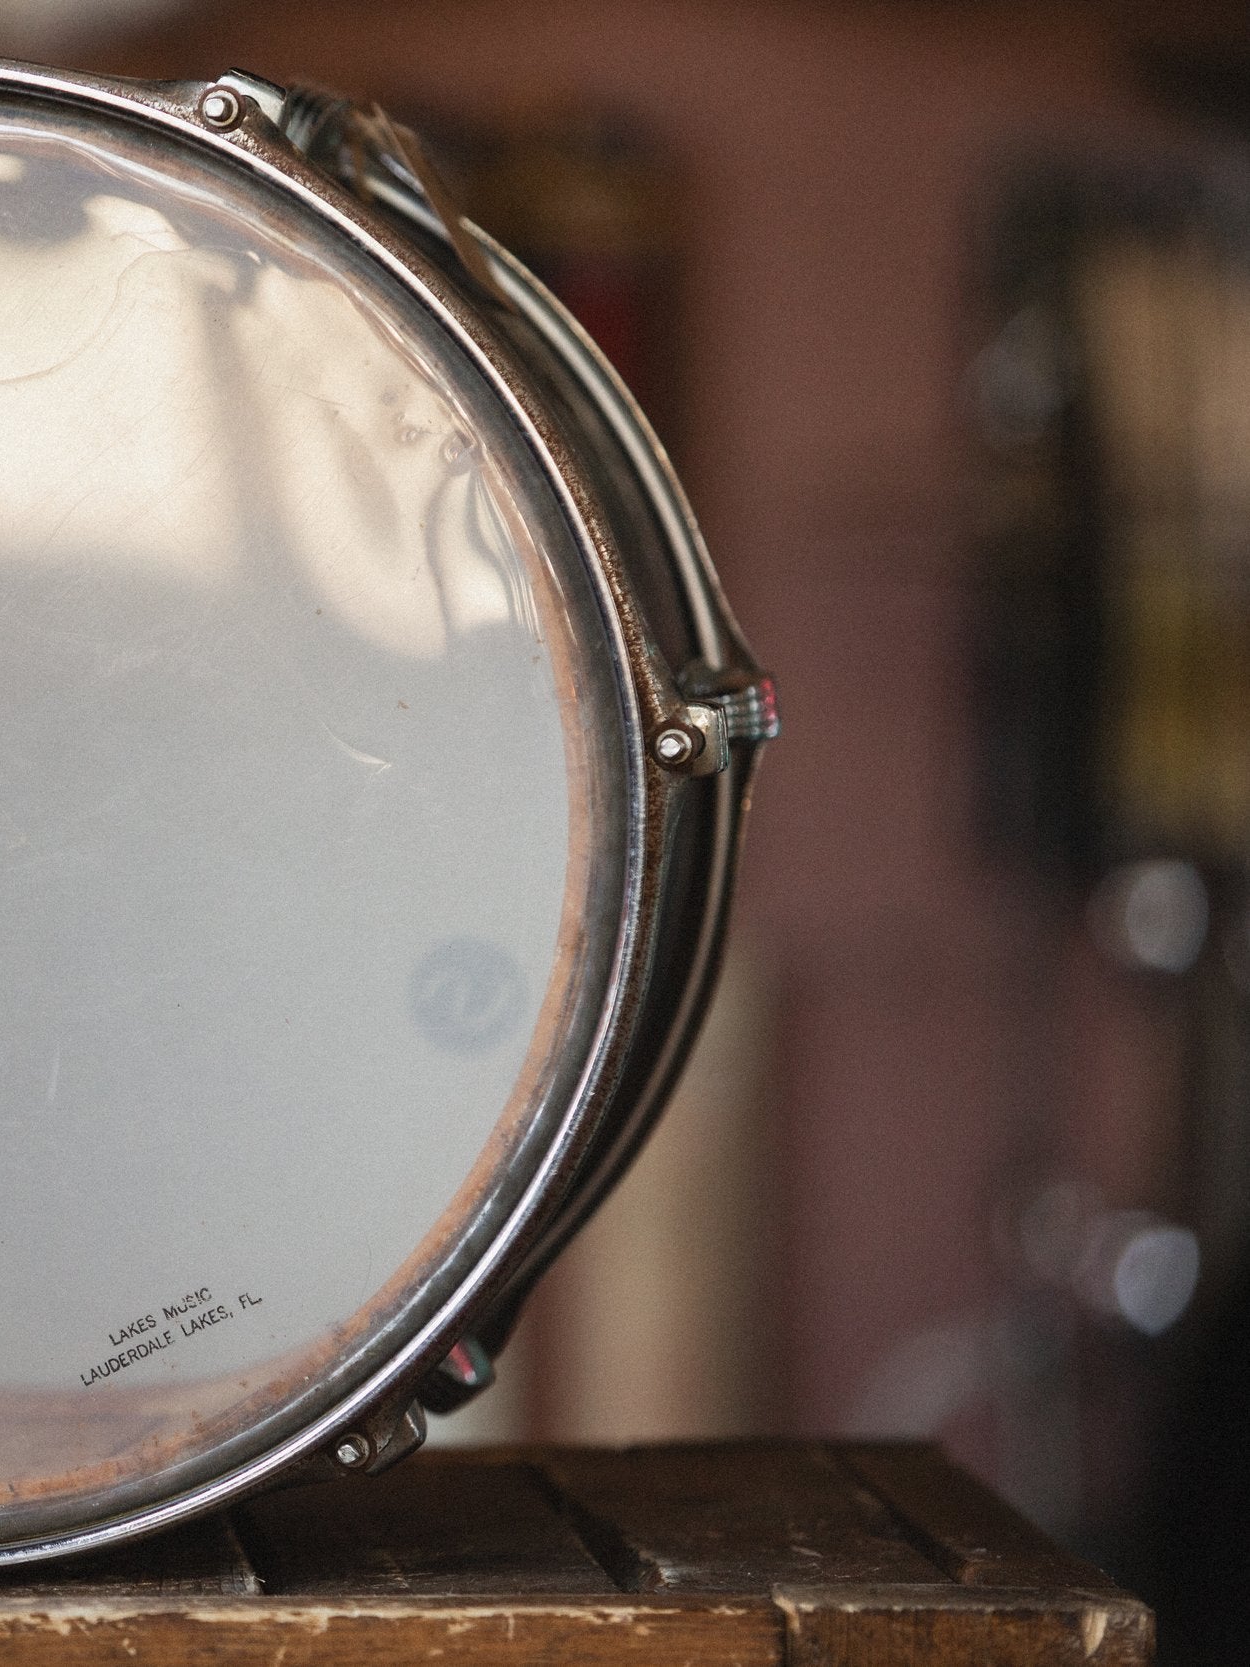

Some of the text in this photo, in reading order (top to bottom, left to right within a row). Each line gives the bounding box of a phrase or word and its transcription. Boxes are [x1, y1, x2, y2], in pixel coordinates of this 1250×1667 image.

[80, 1330, 175, 1386] LAUDERDALE
[180, 1306, 234, 1338] LAKES,
[109, 1287, 212, 1346] LAKES MUSIC
